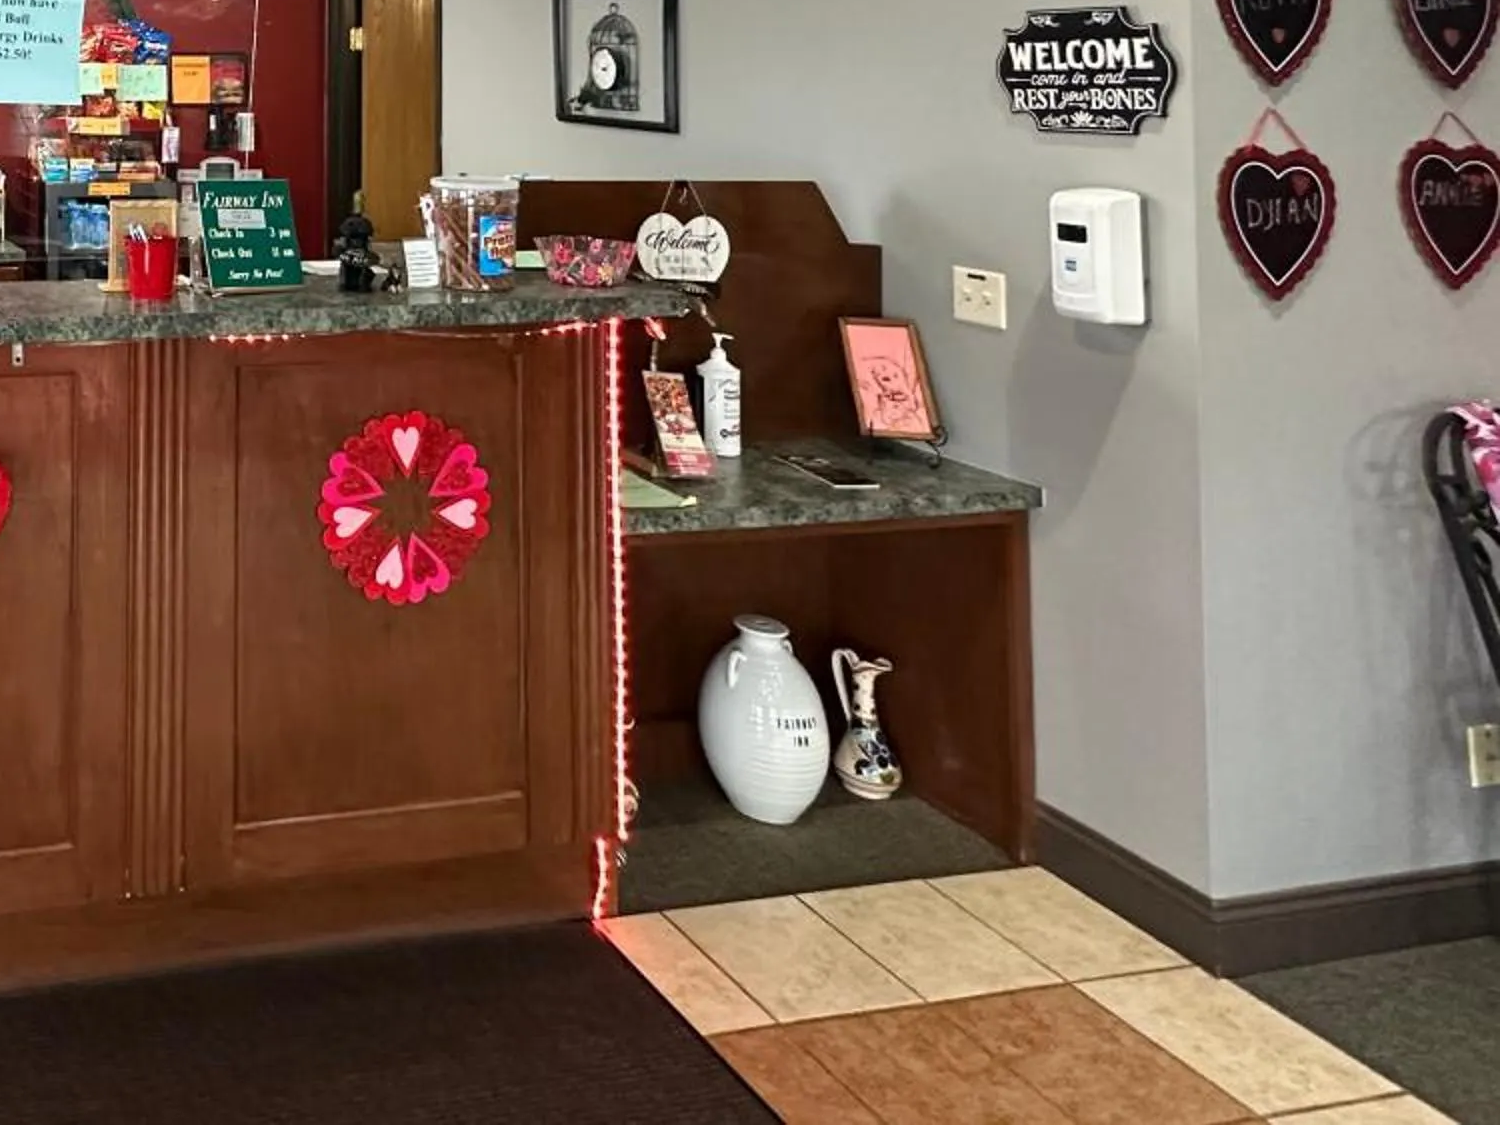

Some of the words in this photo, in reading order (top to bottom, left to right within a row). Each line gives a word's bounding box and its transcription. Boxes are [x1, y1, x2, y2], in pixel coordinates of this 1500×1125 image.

[5, 12, 31, 25] Bull
[23, 30, 63, 44] Drinks
[1007, 36, 1154, 71] WELCOME
[1031, 74, 1068, 86] come
[1071, 72, 1088, 85] in
[1093, 66, 1127, 85] and
[1012, 88, 1059, 110] REST
[1058, 90, 1091, 110] your
[1089, 87, 1157, 110] BONES
[644, 228, 720, 254] Welcome
